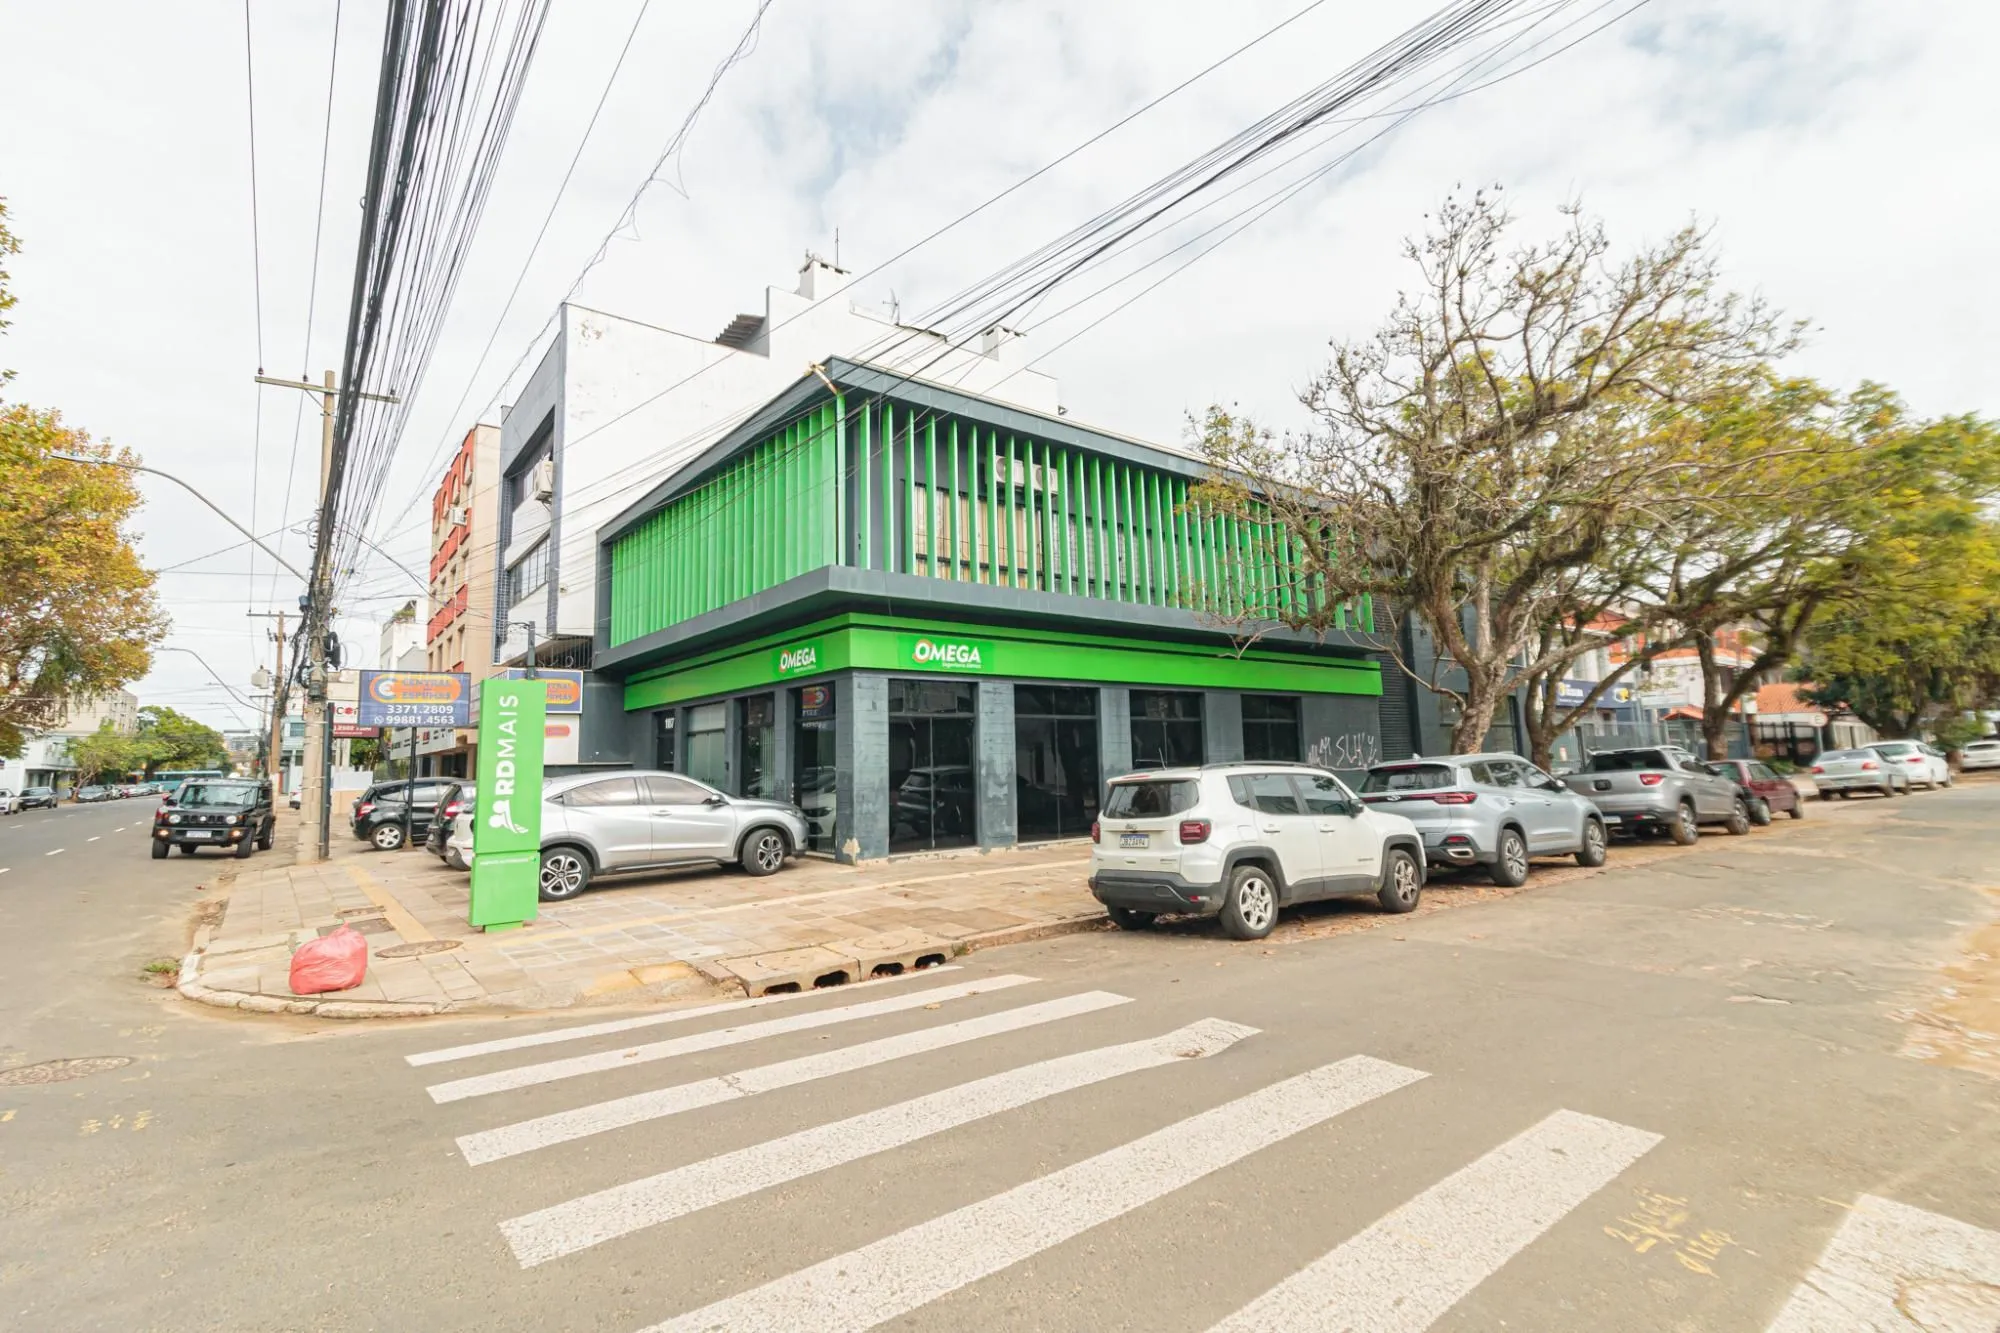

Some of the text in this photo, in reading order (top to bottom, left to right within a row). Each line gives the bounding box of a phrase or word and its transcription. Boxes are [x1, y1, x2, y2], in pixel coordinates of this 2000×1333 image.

[780, 647, 816, 669] OMEGA
[915, 641, 982, 663] OMEGA
[387, 704, 454, 714] 3371.2809
[495, 694, 519, 796] RDMAIS
